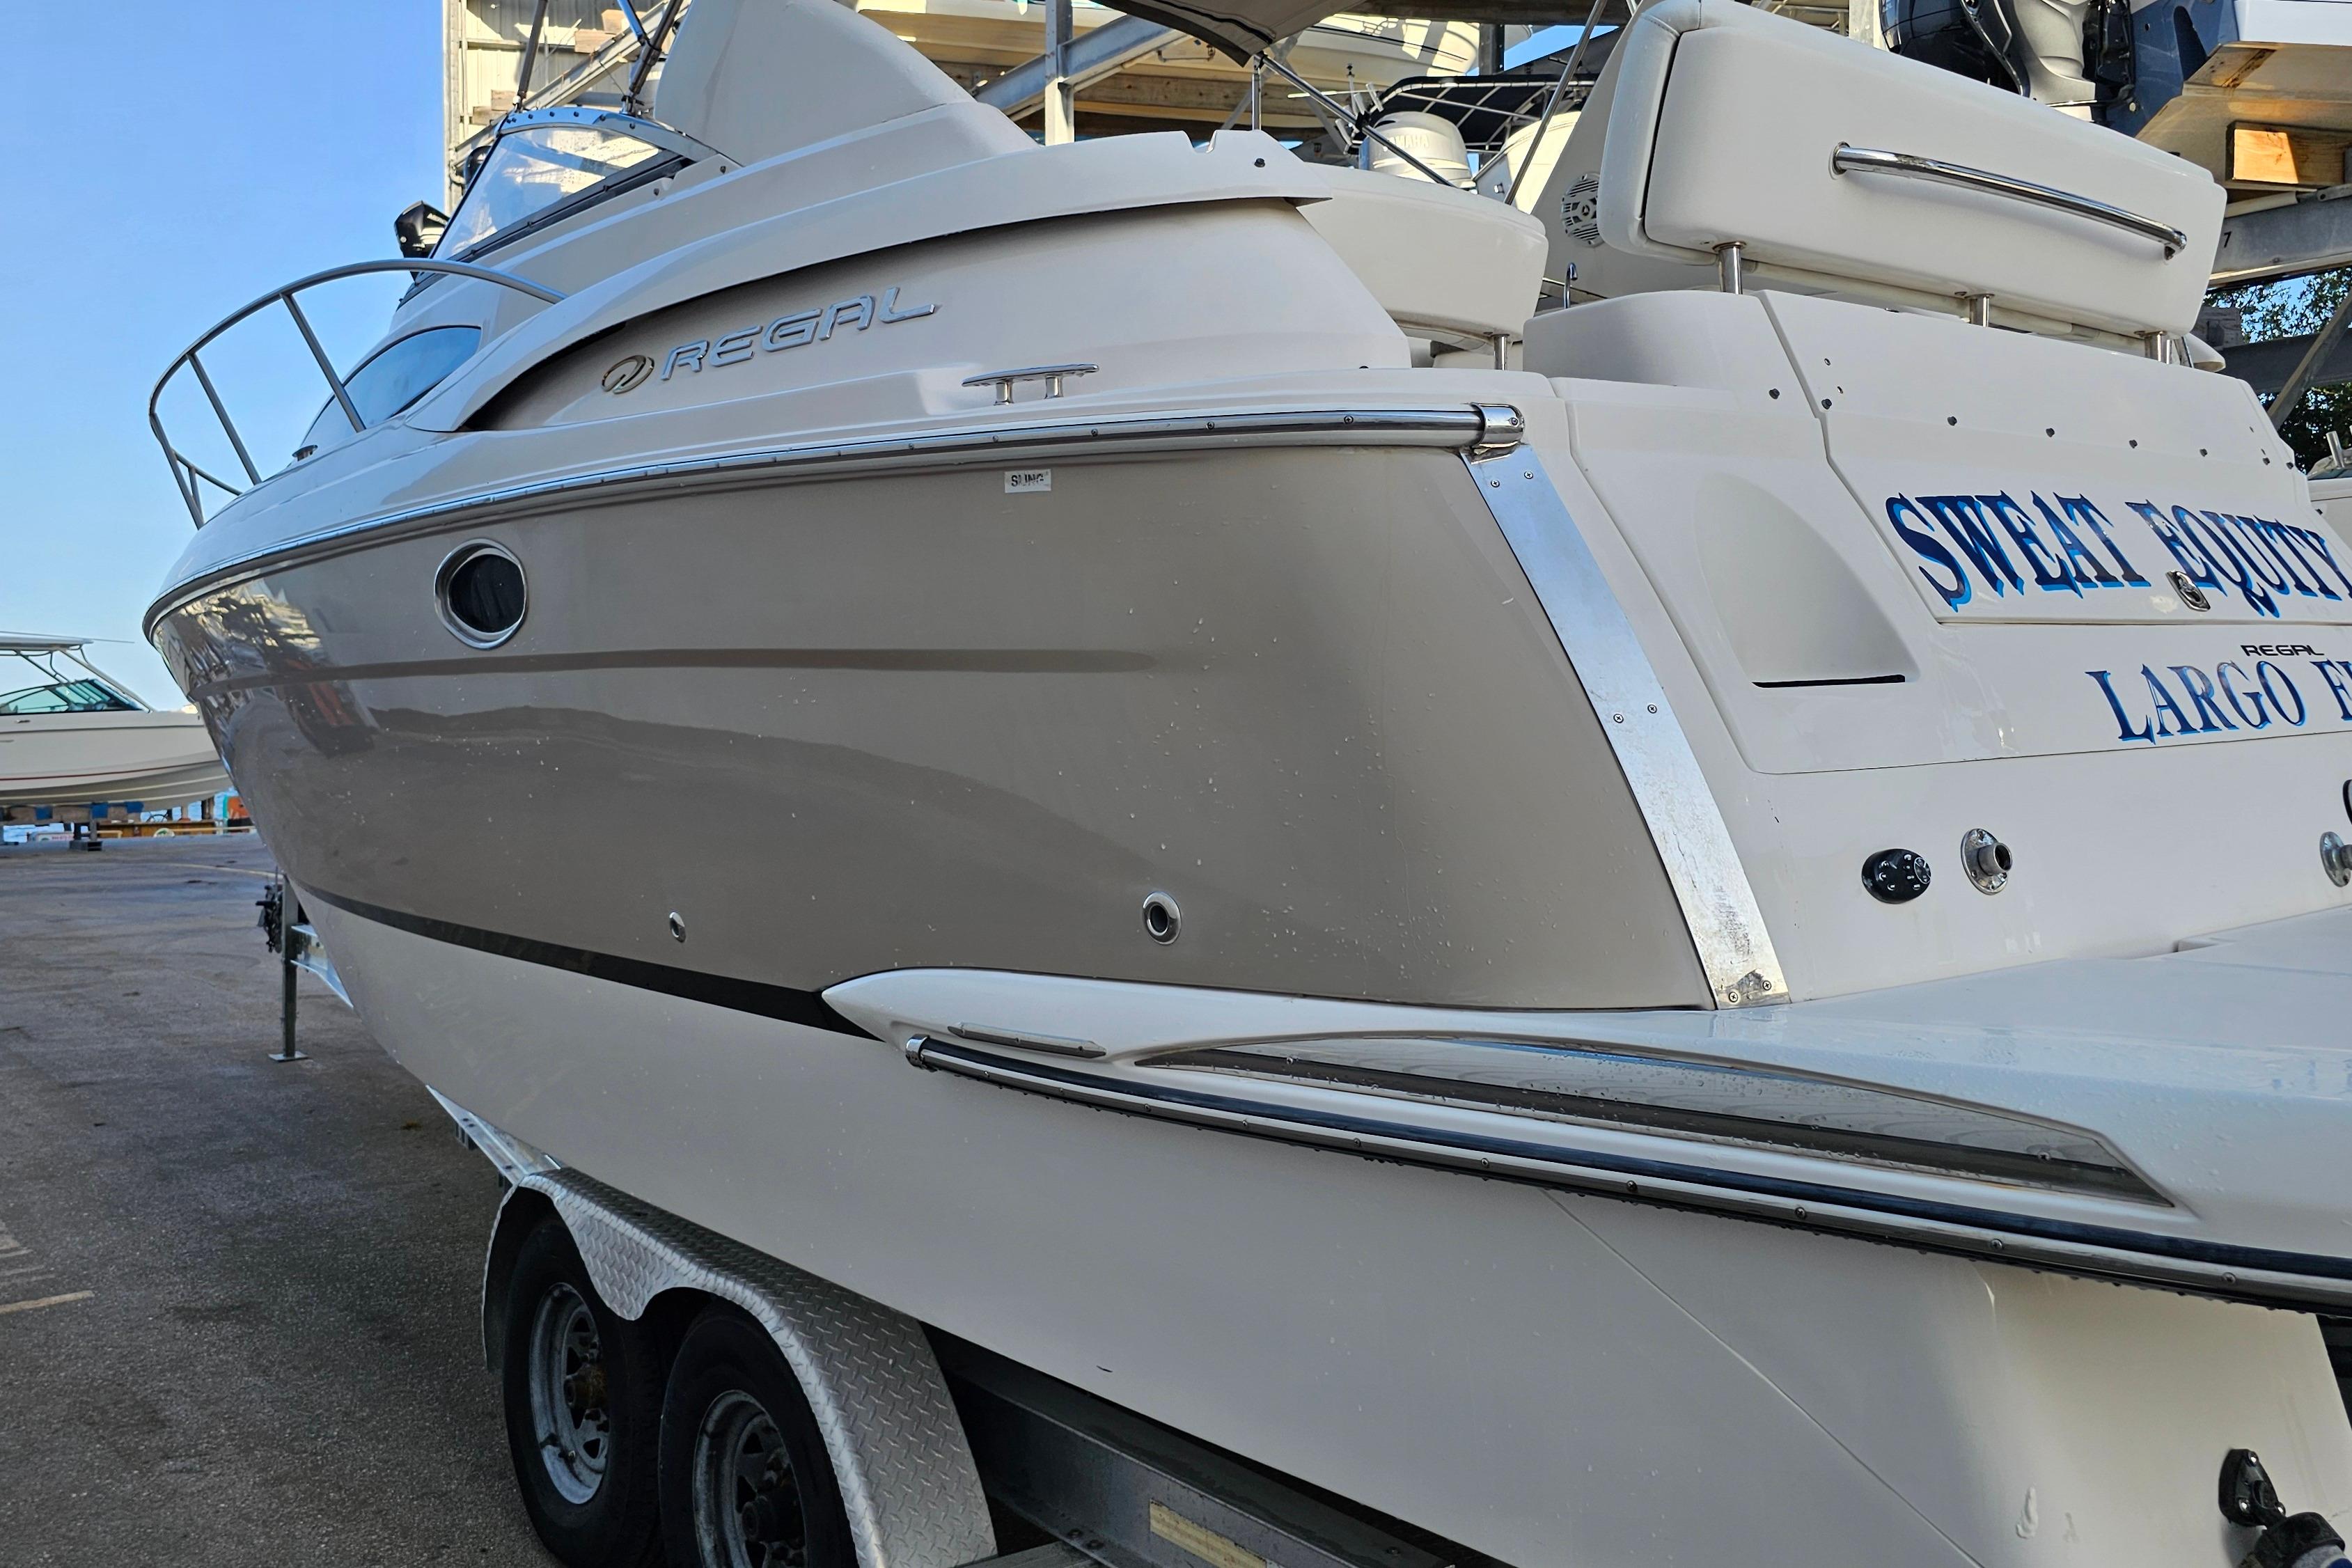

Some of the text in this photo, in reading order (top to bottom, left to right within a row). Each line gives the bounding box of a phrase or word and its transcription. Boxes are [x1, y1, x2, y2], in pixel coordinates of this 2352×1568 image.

[1383, 134, 1429, 152] MAHA
[661, 288, 935, 380] REGAL
[1885, 491, 2352, 618] SWEAT EQUITY
[2241, 645, 2325, 657] REGAL
[2085, 659, 2352, 745] LARGO F
